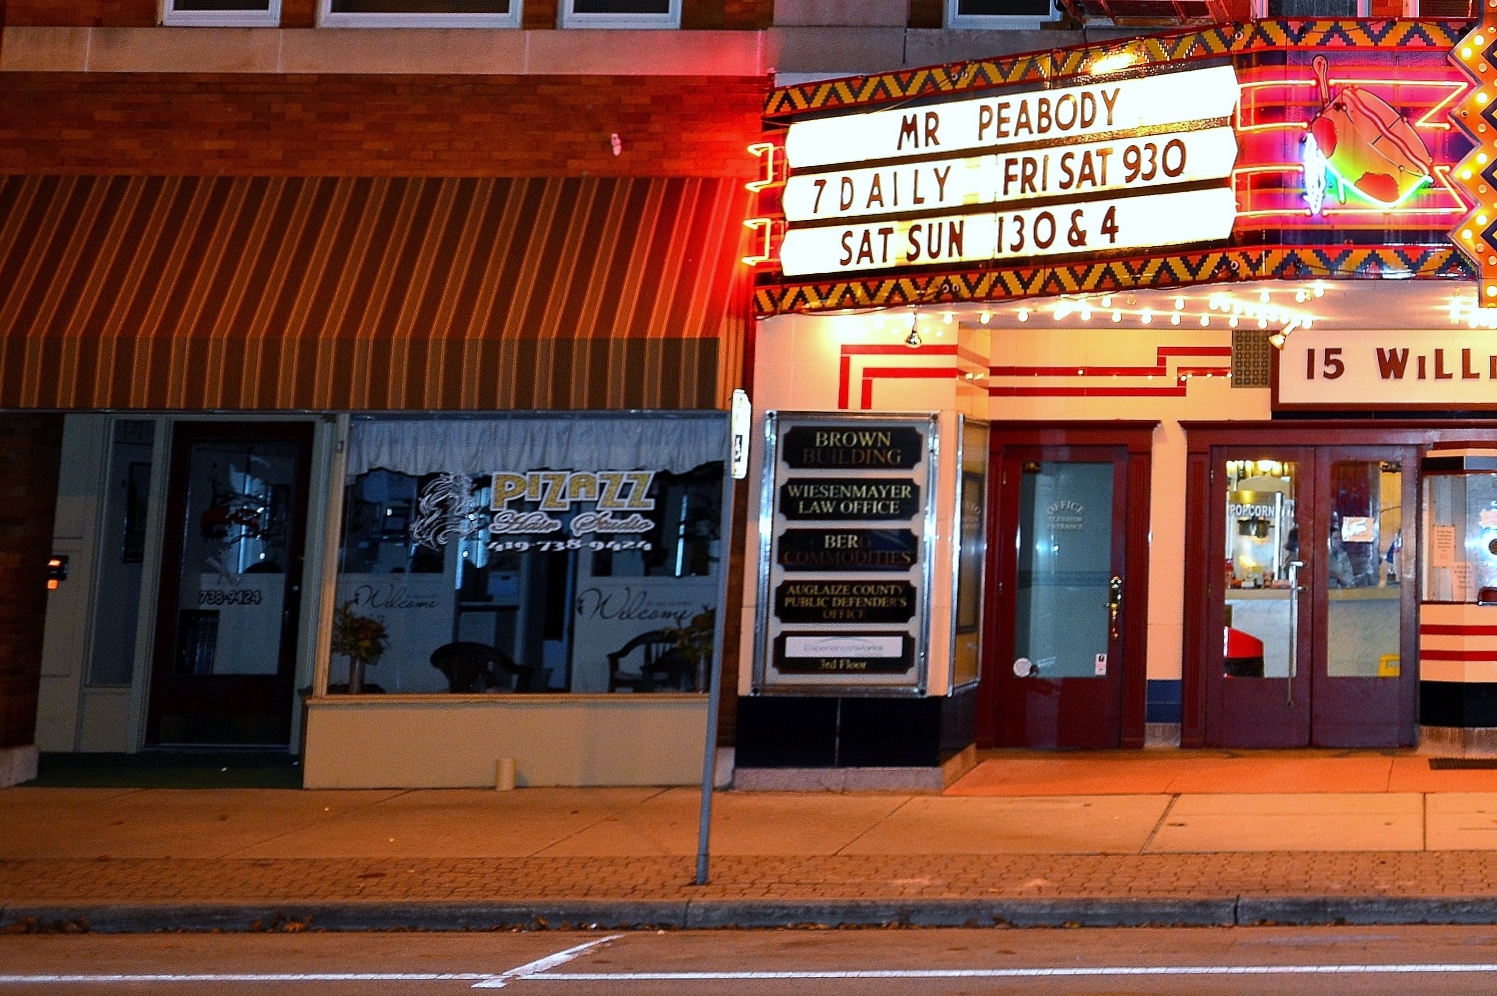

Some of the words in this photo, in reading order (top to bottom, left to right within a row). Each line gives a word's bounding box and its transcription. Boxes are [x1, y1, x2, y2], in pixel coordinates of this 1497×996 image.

[898, 111, 940, 150] MR
[978, 87, 1121, 142] PEABODY
[812, 179, 826, 214] 7
[840, 166, 952, 211] DAILY
[1003, 156, 1049, 195] FRI
[1059, 147, 1108, 190] SAT
[1123, 138, 1187, 182] 930
[839, 227, 893, 267] SAT
[906, 219, 965, 262] SUN
[997, 211, 1055, 254] 130
[1066, 210, 1087, 244] &
[1100, 205, 1119, 243] 4
[1305, 346, 1345, 380] 15
[815, 431, 891, 447] BROWN
[803, 448, 901, 464] BUILDING
[490, 470, 655, 511] PIZAZZ
[787, 485, 912, 499] WIESENMAYER
[799, 500, 836, 514] LAW
[840, 500, 900, 514] OFFICE
[1046, 500, 1085, 515] OFFICE
[1230, 504, 1275, 517] POPCORN
[489, 510, 561, 534] Hair
[570, 510, 655, 537] Studio
[487, 539, 652, 552] 419-738-9424
[784, 550, 912, 565] COMMODITIES
[199, 590, 261, 605] 738-9424
[786, 584, 850, 596] AUGLAIZE
[852, 584, 904, 596] COUNTY
[577, 587, 694, 621] Welcome
[784, 596, 829, 608] PUBLIC
[823, 608, 864, 620] OFFICE
[840, 659, 867, 671] Floor
